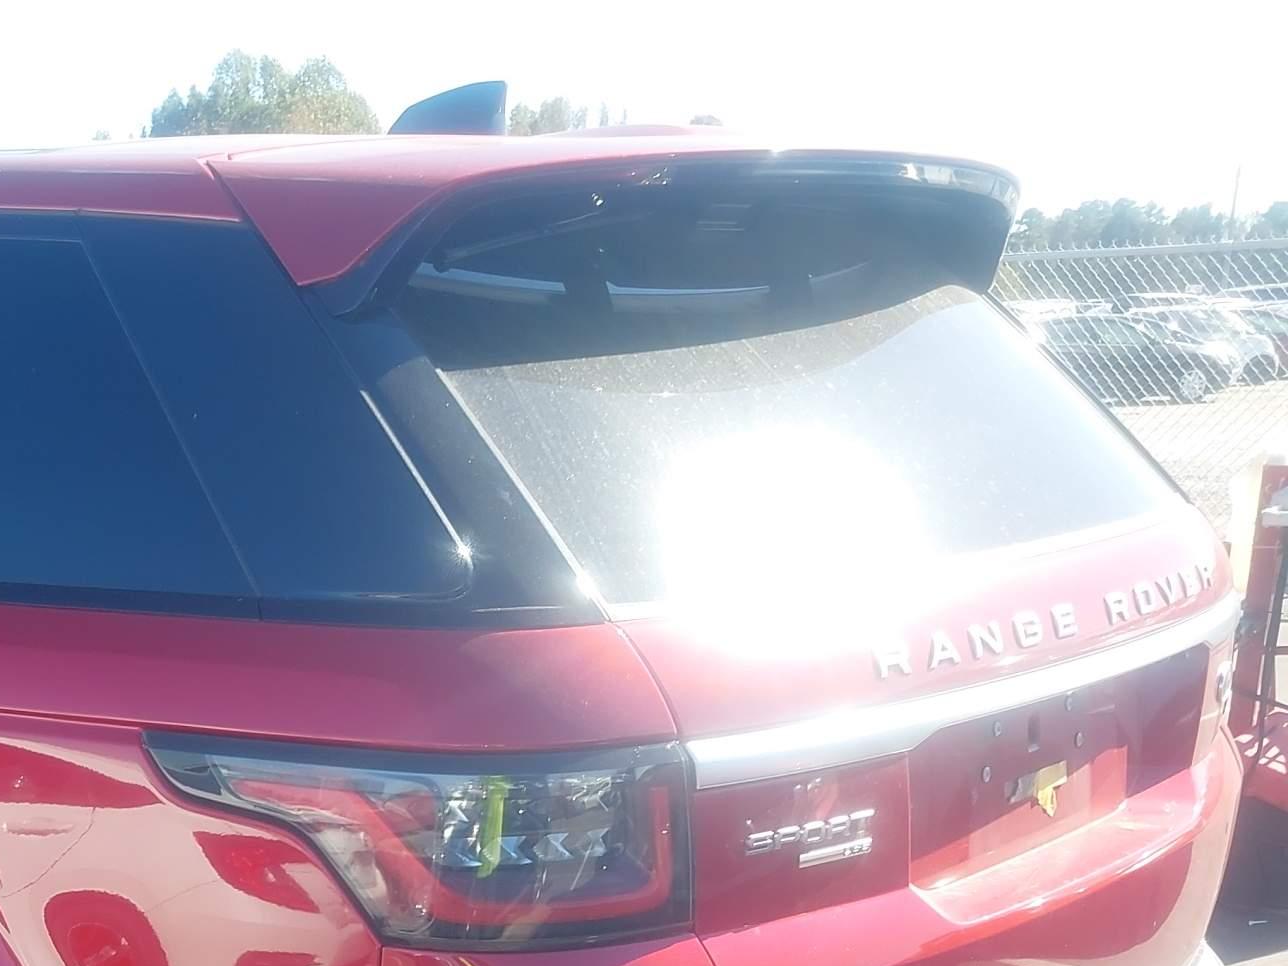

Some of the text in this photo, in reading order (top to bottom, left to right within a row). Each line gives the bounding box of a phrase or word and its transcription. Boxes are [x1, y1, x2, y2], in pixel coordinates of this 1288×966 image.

[872, 564, 1216, 679] RANGE ROVER
[744, 808, 875, 852] SPORT
